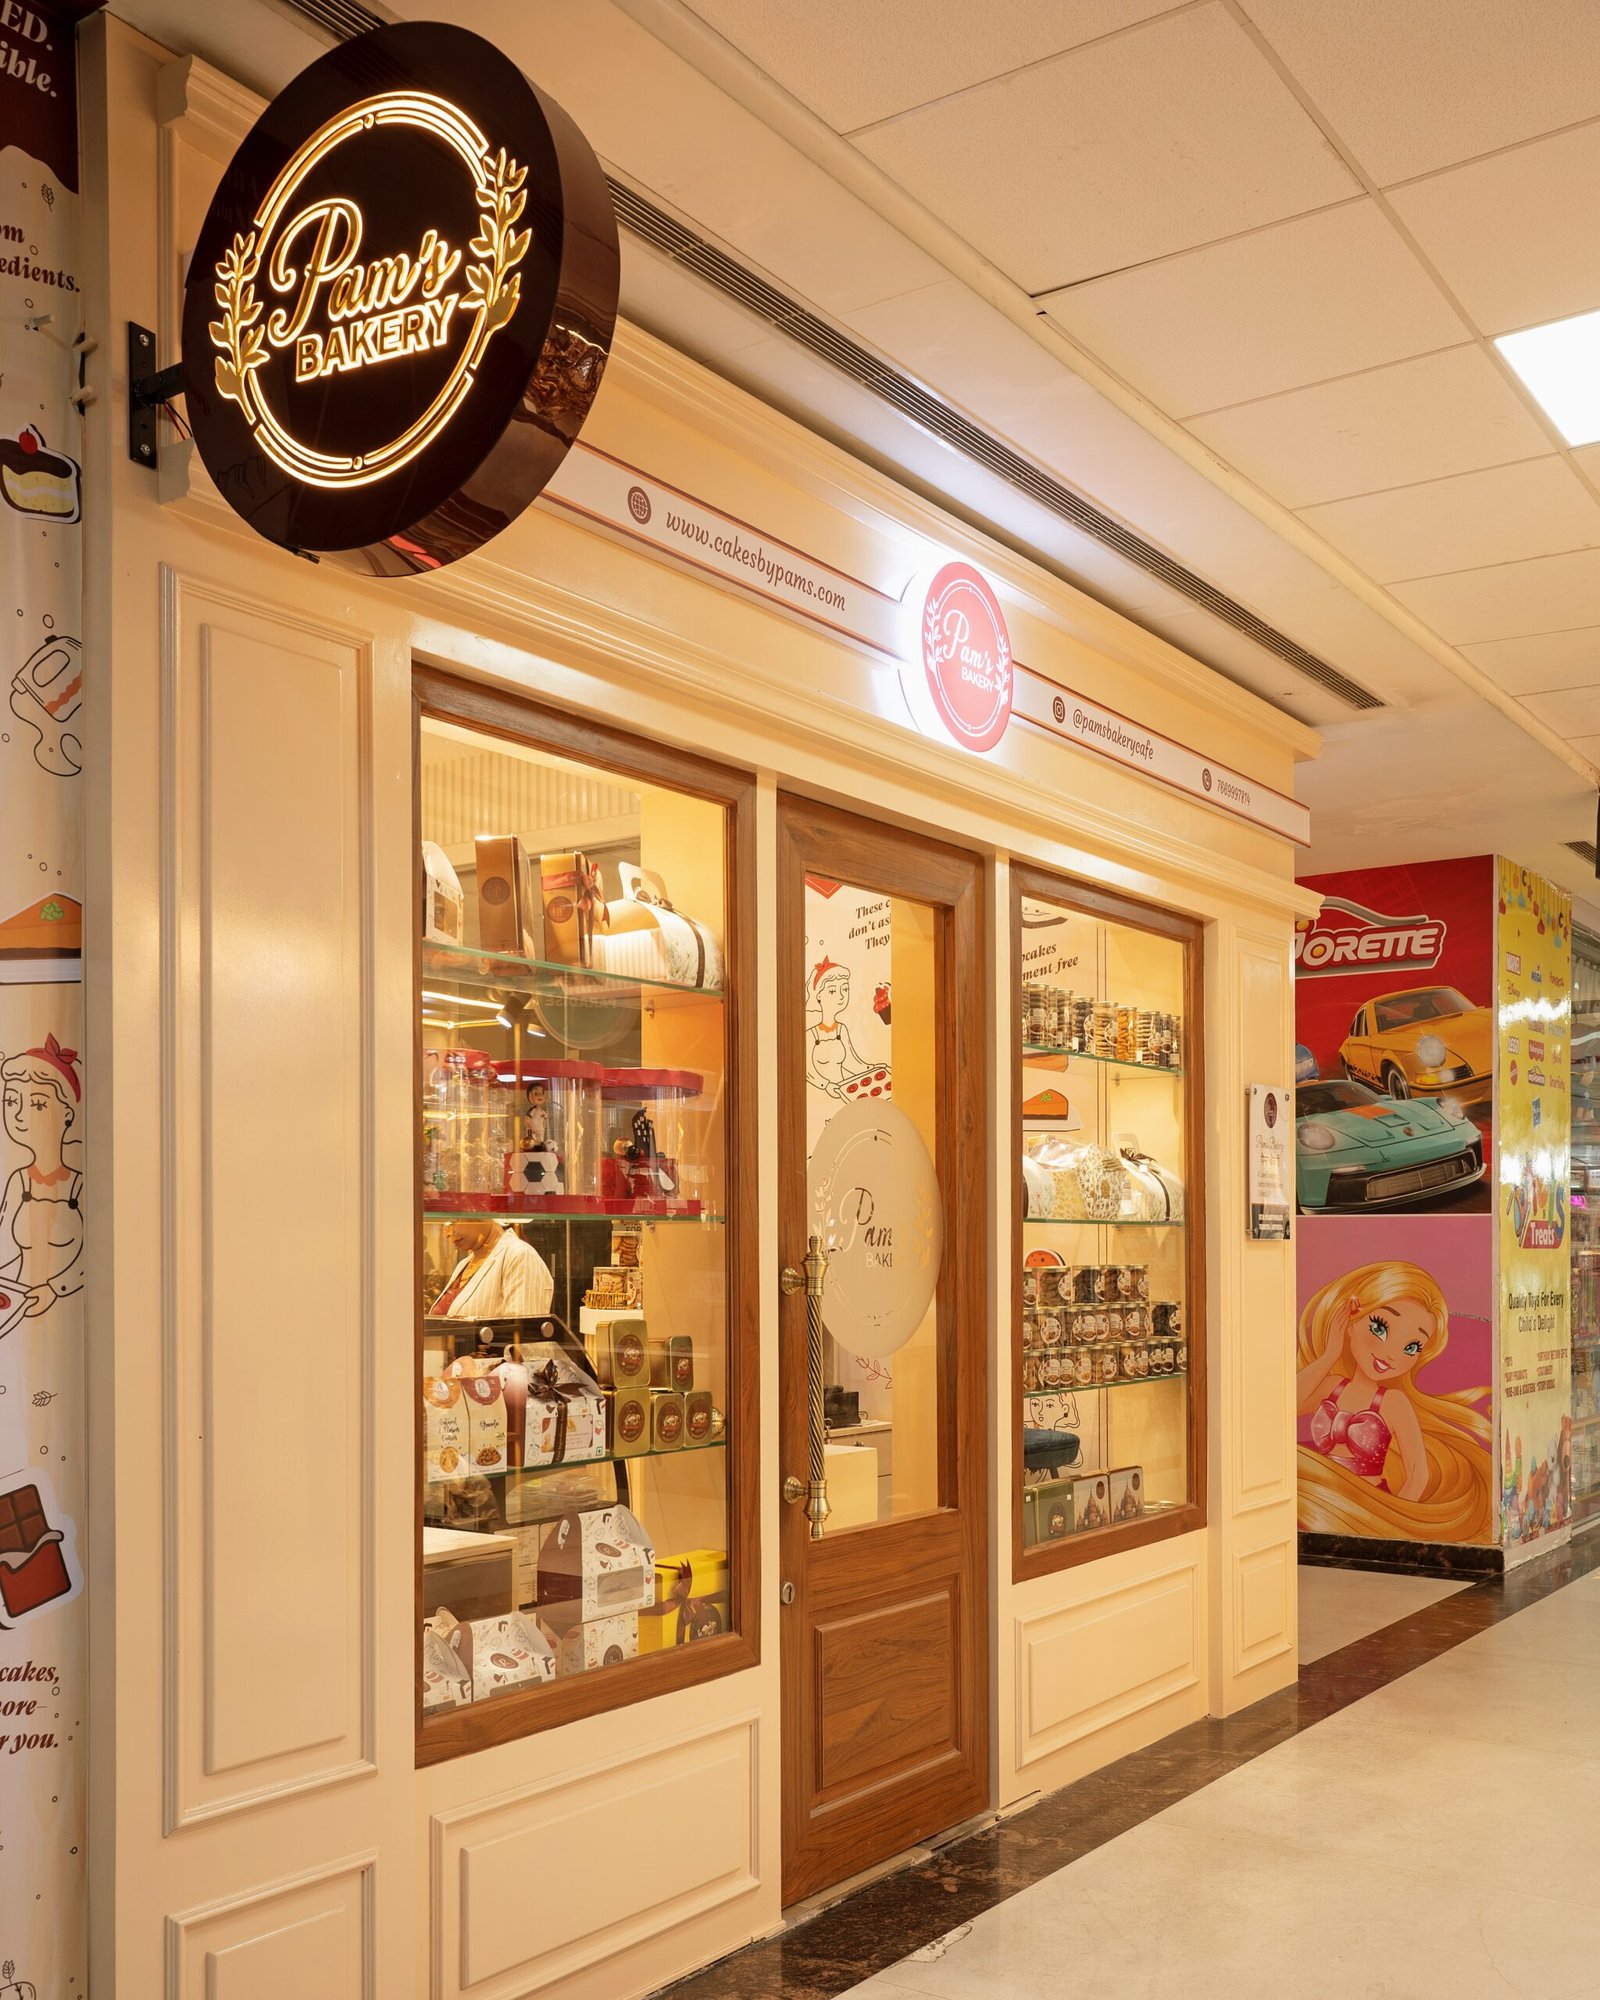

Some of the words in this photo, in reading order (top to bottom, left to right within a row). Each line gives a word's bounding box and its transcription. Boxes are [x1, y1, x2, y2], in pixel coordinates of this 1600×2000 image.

[267, 197, 462, 348] Pam's
[295, 292, 460, 383] BAKERY
[666, 511, 846, 611] www.cakesbypams.com
[942, 608, 994, 674] Pam's
[961, 666, 995, 693] BAKERY
[1072, 708, 1154, 761] @pamsbakerycafe
[855, 902, 883, 919] These
[848, 920, 875, 940] don't
[865, 934, 891, 950] They
[1054, 956, 1079, 975] free
[1530, 1222, 1555, 1246] Treats
[1509, 1293, 1527, 1311] Quality
[1541, 1291, 1550, 1307] For
[1550, 1290, 1564, 1309] Every
[9, 1733, 59, 1755] you.
